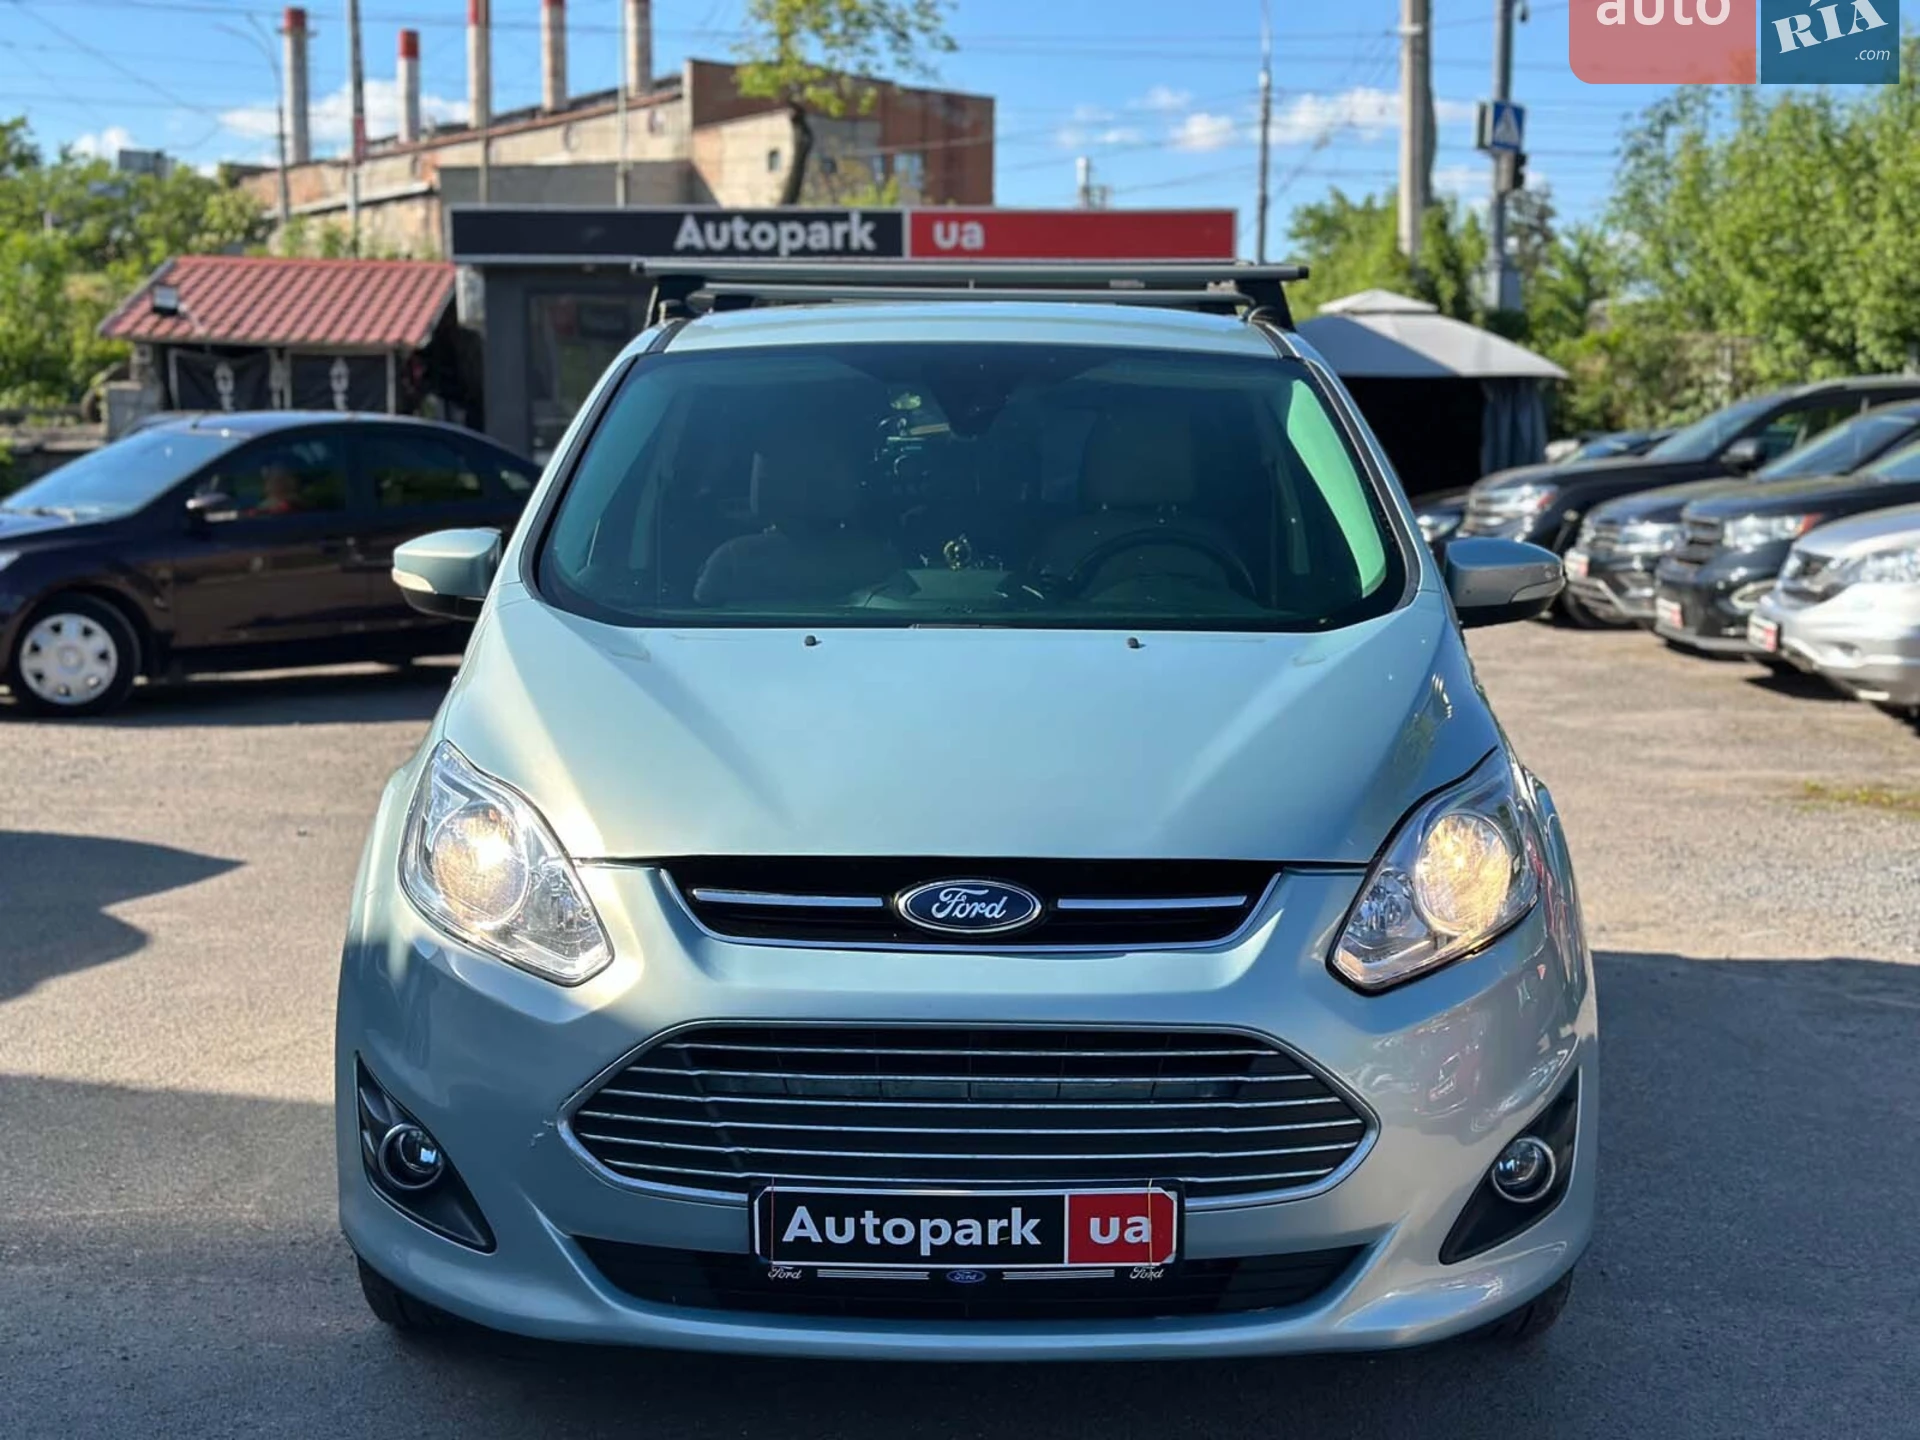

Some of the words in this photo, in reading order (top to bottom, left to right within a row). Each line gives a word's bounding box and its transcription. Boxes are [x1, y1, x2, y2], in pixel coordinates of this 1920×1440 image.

[673, 210, 876, 257] Autopark
[933, 219, 985, 250] ua
[931, 887, 1008, 919] Ford
[782, 1205, 1041, 1257] Autopark
[1089, 1216, 1151, 1245] ua
[767, 1265, 802, 1279] Ford
[1129, 1266, 1164, 1279] Ford
